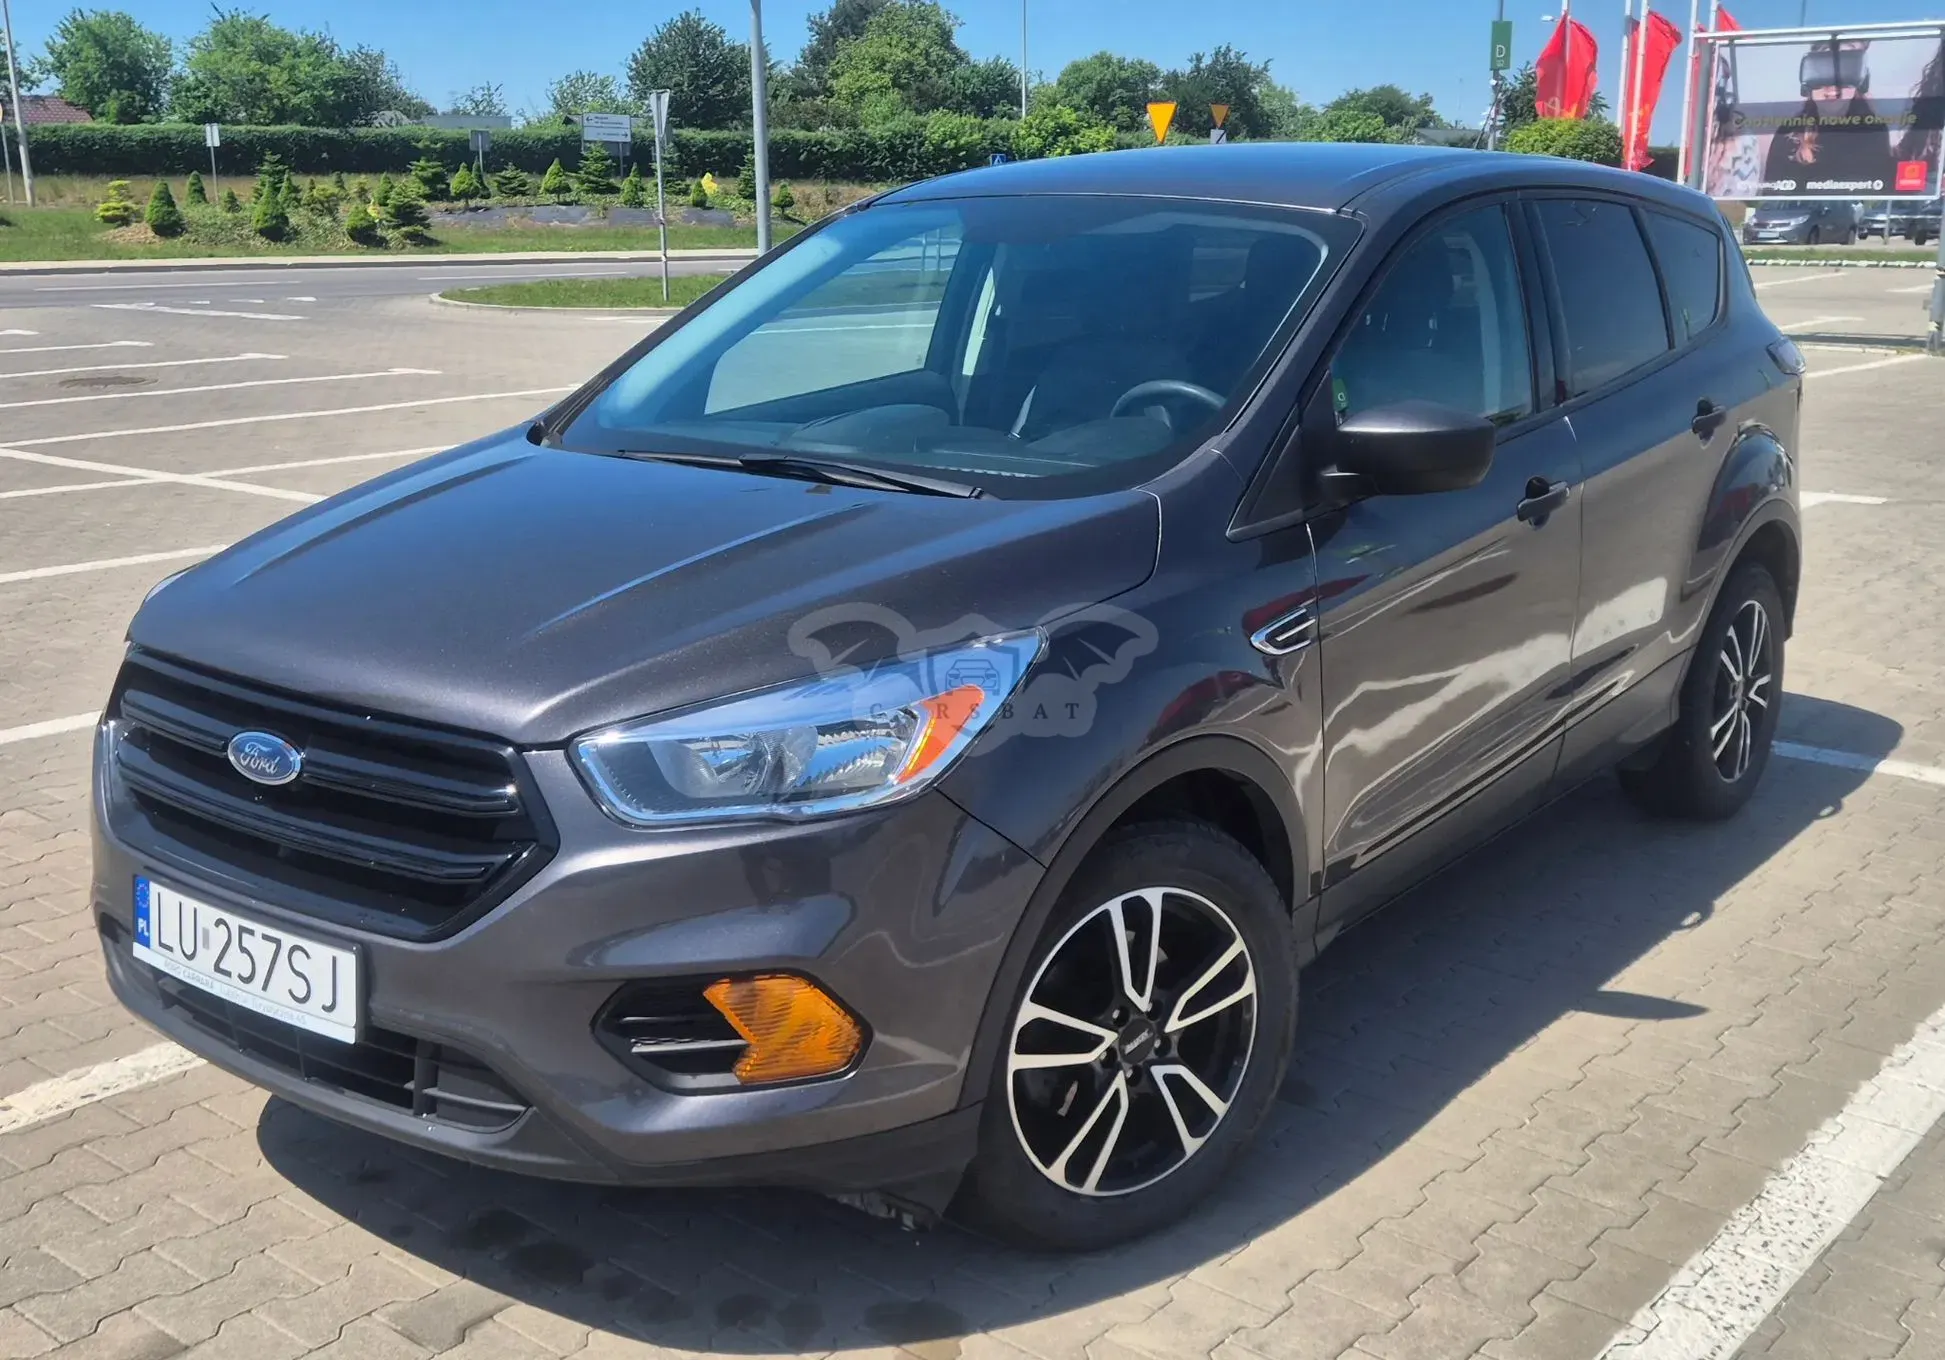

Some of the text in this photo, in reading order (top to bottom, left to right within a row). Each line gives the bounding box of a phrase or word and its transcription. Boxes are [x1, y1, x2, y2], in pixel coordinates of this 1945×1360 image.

[1495, 44, 1506, 58] D
[1818, 115, 1861, 126] nowe
[240, 741, 282, 774] Ford
[137, 917, 149, 937] PL
[157, 892, 198, 962] LU
[213, 917, 337, 1013] 257SJ
